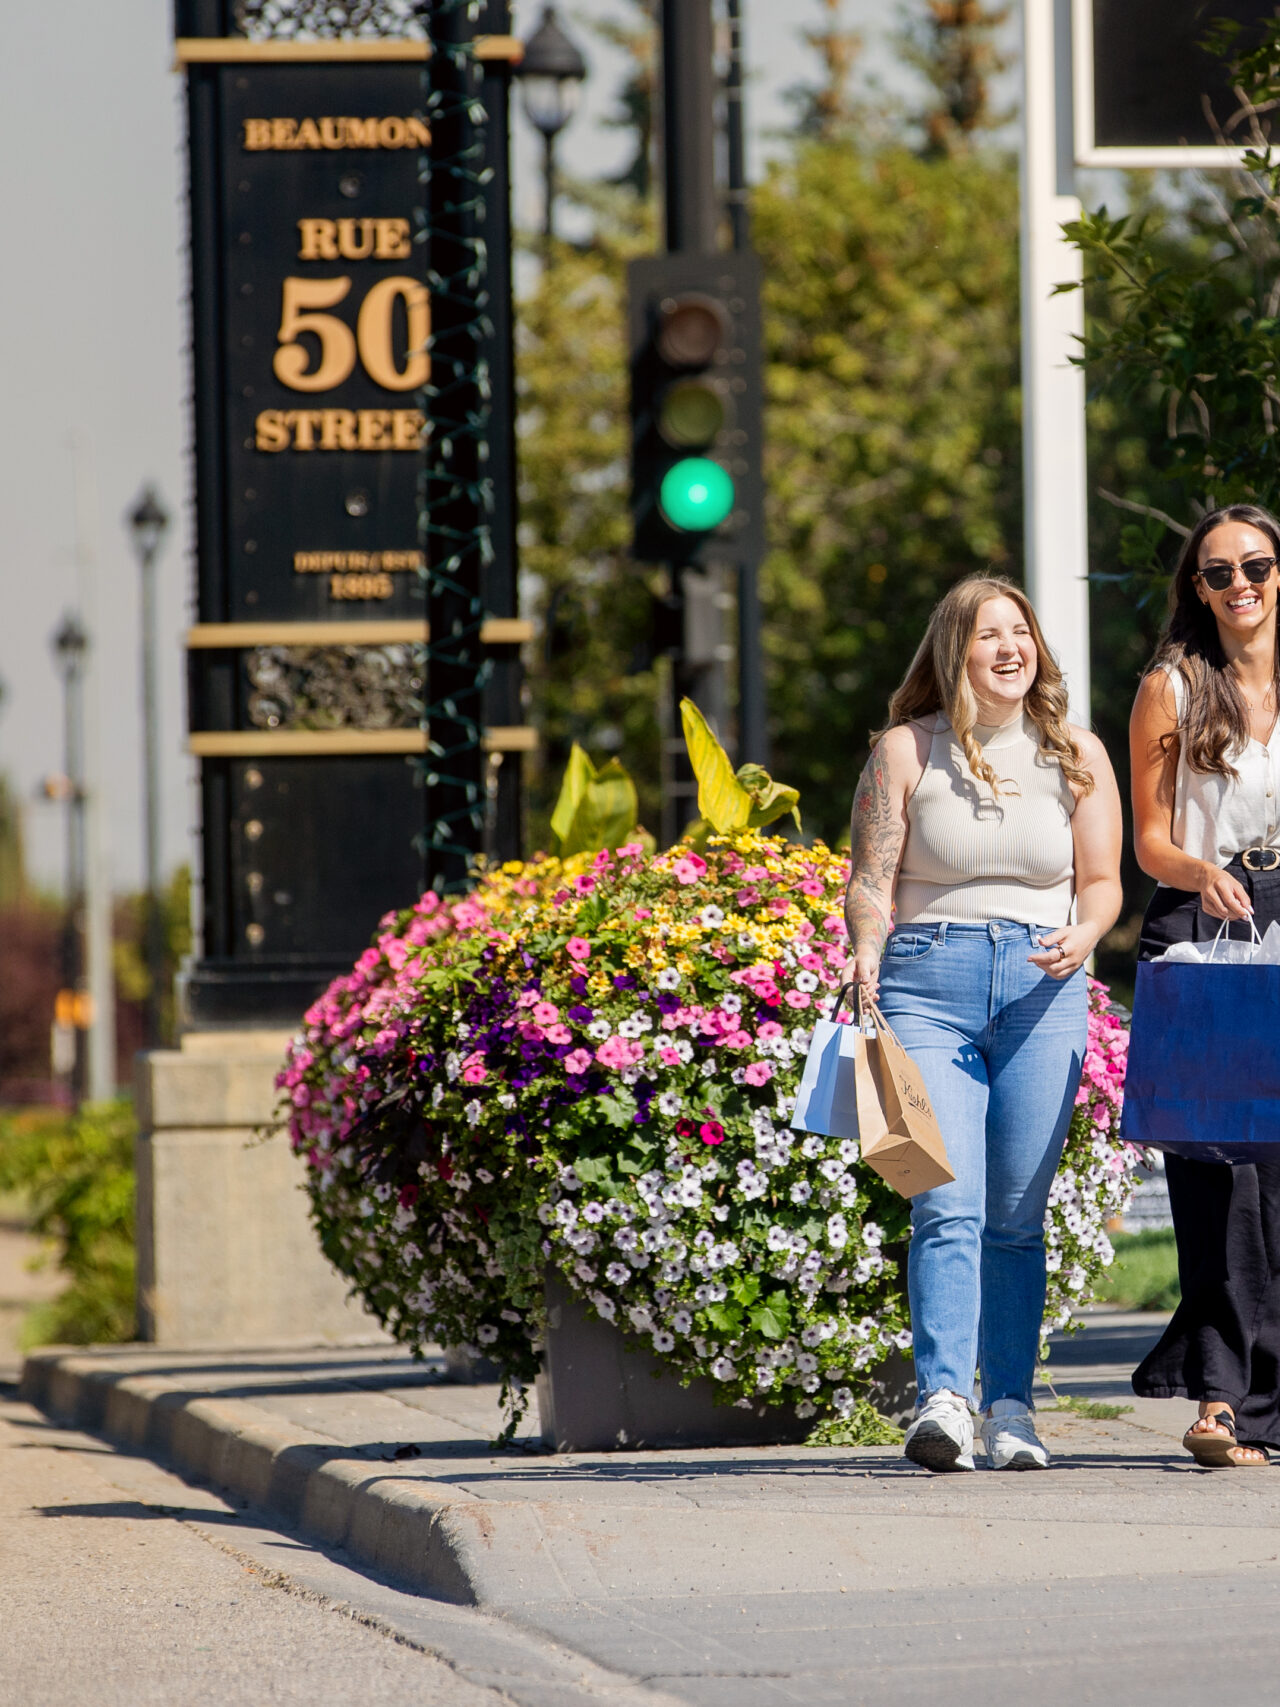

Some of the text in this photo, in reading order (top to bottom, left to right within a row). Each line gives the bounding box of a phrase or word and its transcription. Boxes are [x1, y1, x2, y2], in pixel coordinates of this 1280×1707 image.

[244, 117, 432, 150] BEAUMON
[297, 218, 411, 260] RUE
[273, 275, 432, 392] 50
[256, 408, 426, 451] STREE
